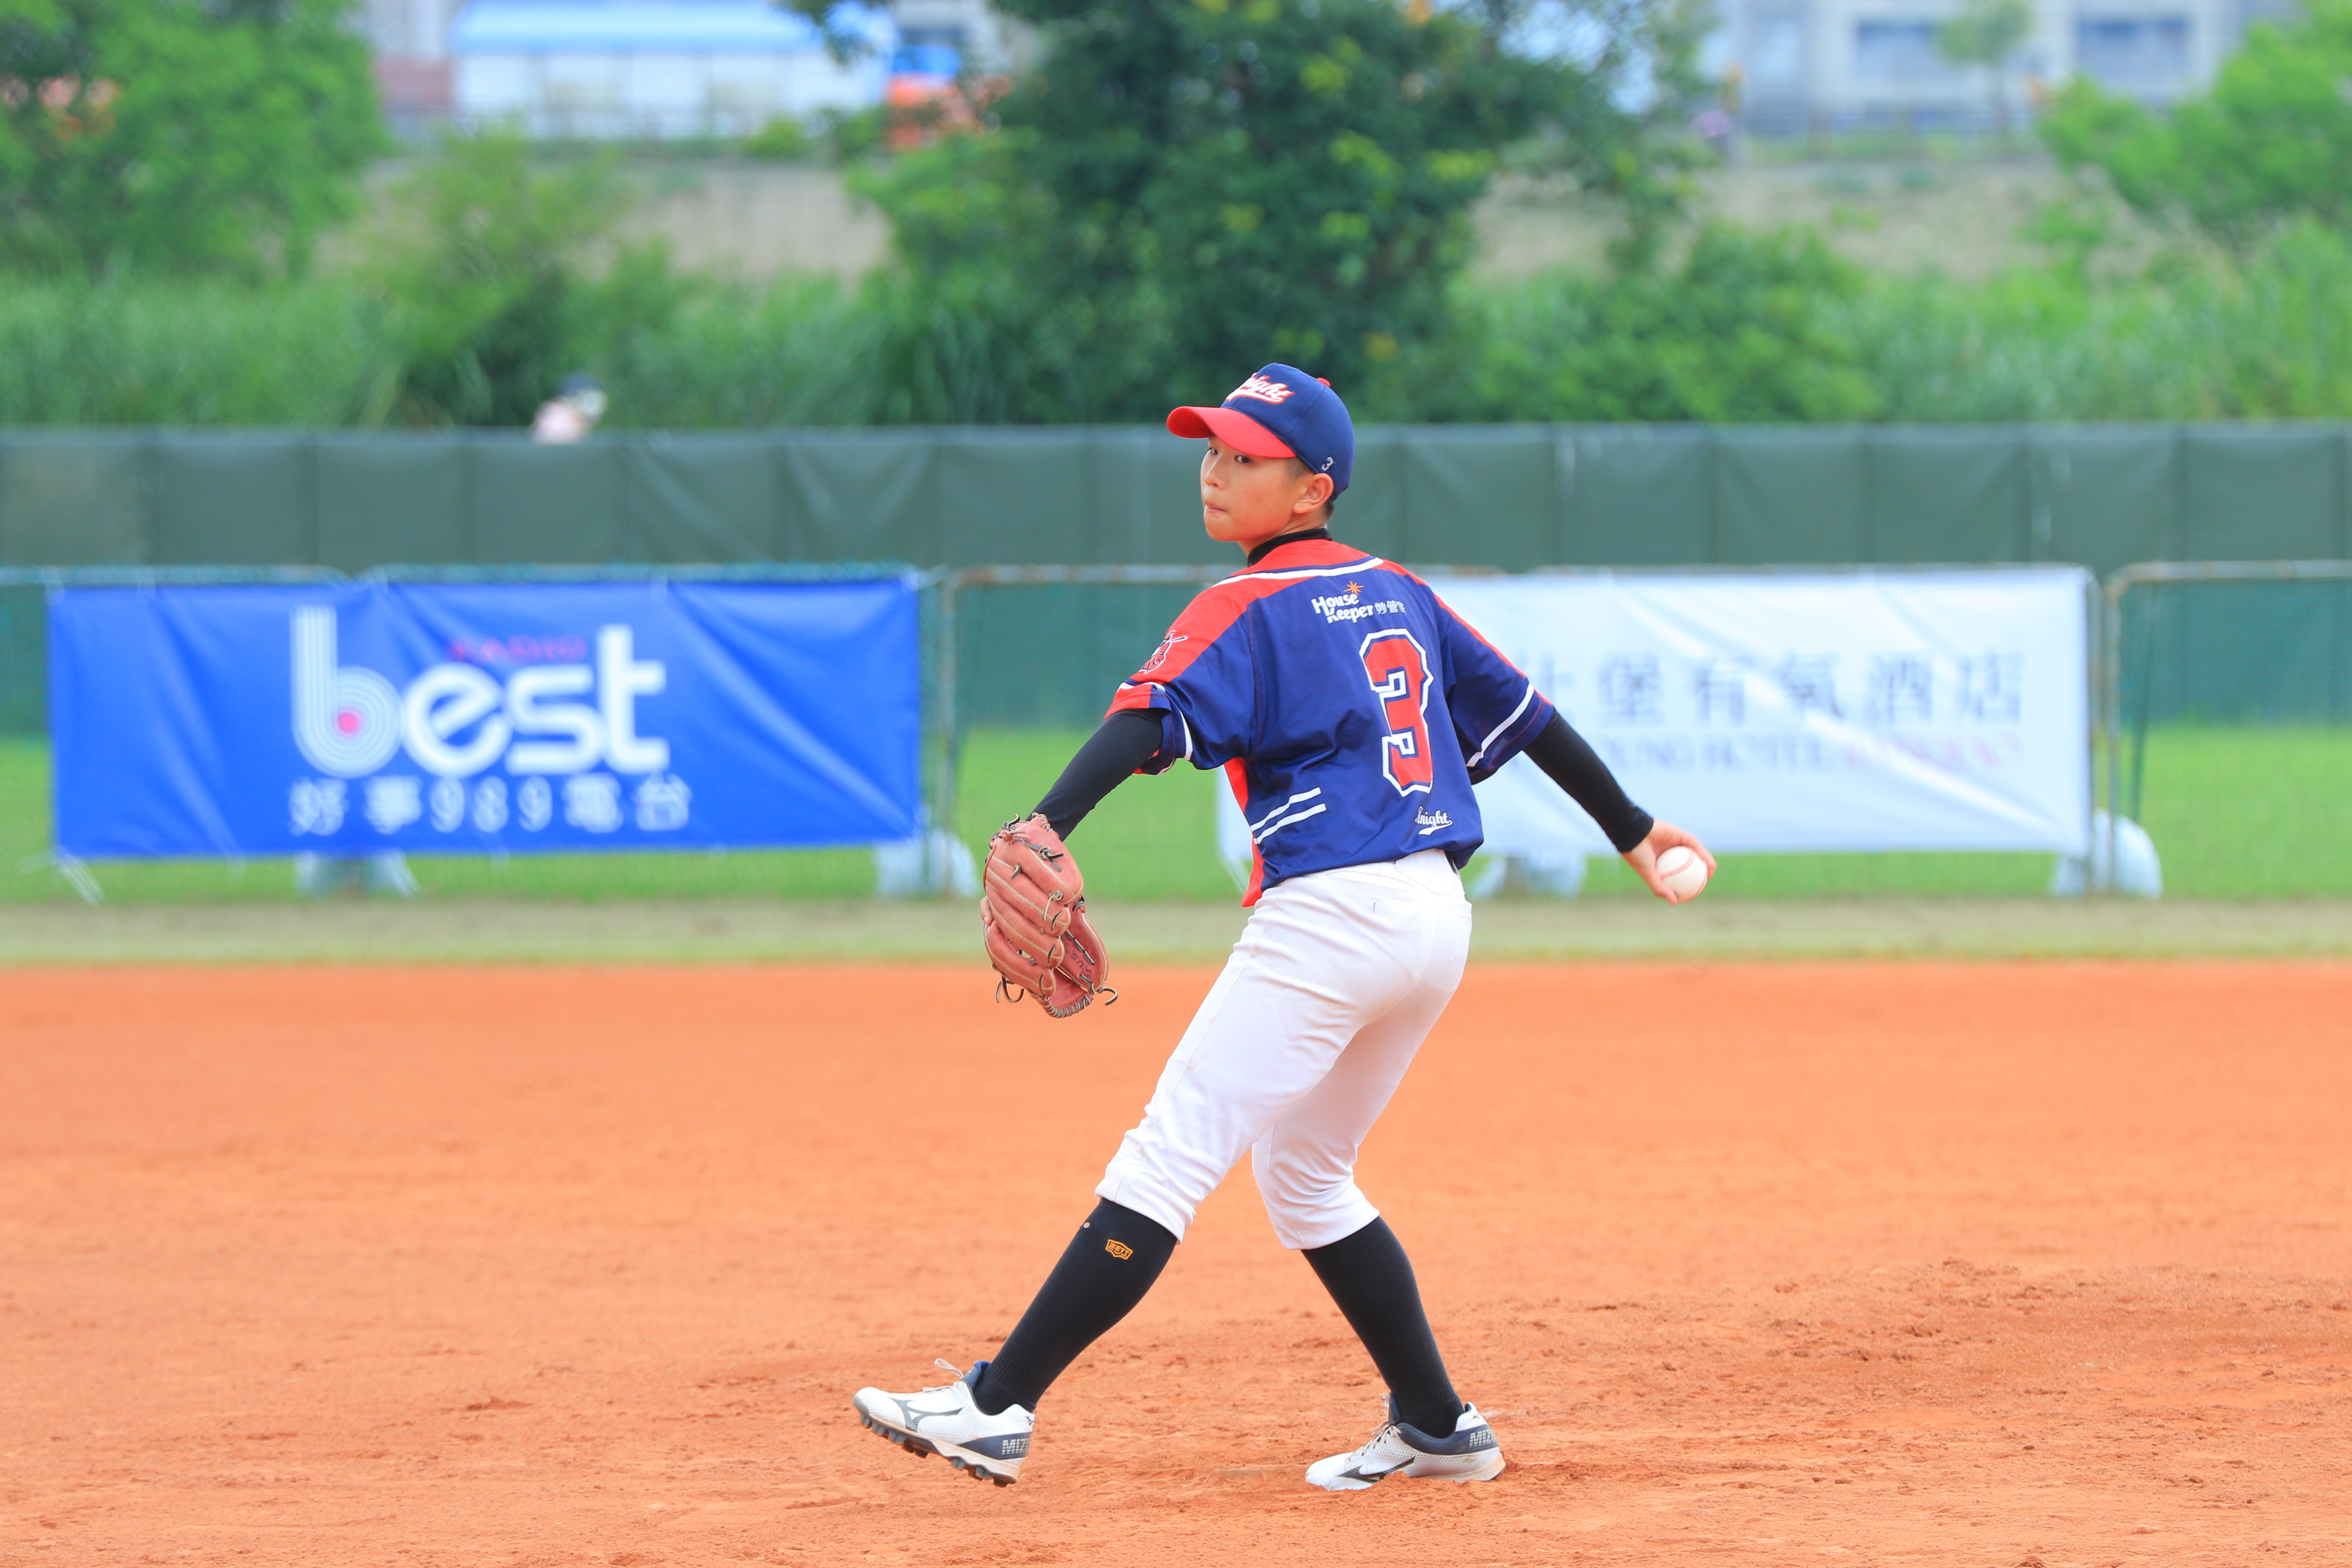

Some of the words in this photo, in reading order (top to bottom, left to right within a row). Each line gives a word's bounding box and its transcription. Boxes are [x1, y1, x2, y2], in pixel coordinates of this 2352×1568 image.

[1233, 372, 1295, 403] night
[1321, 456, 1334, 471] 3
[1311, 594, 1360, 616] House
[1326, 604, 1374, 624] Keeper
[290, 604, 670, 778] best
[1359, 628, 1434, 797] 3
[1108, 1242, 1130, 1258] ZETT
